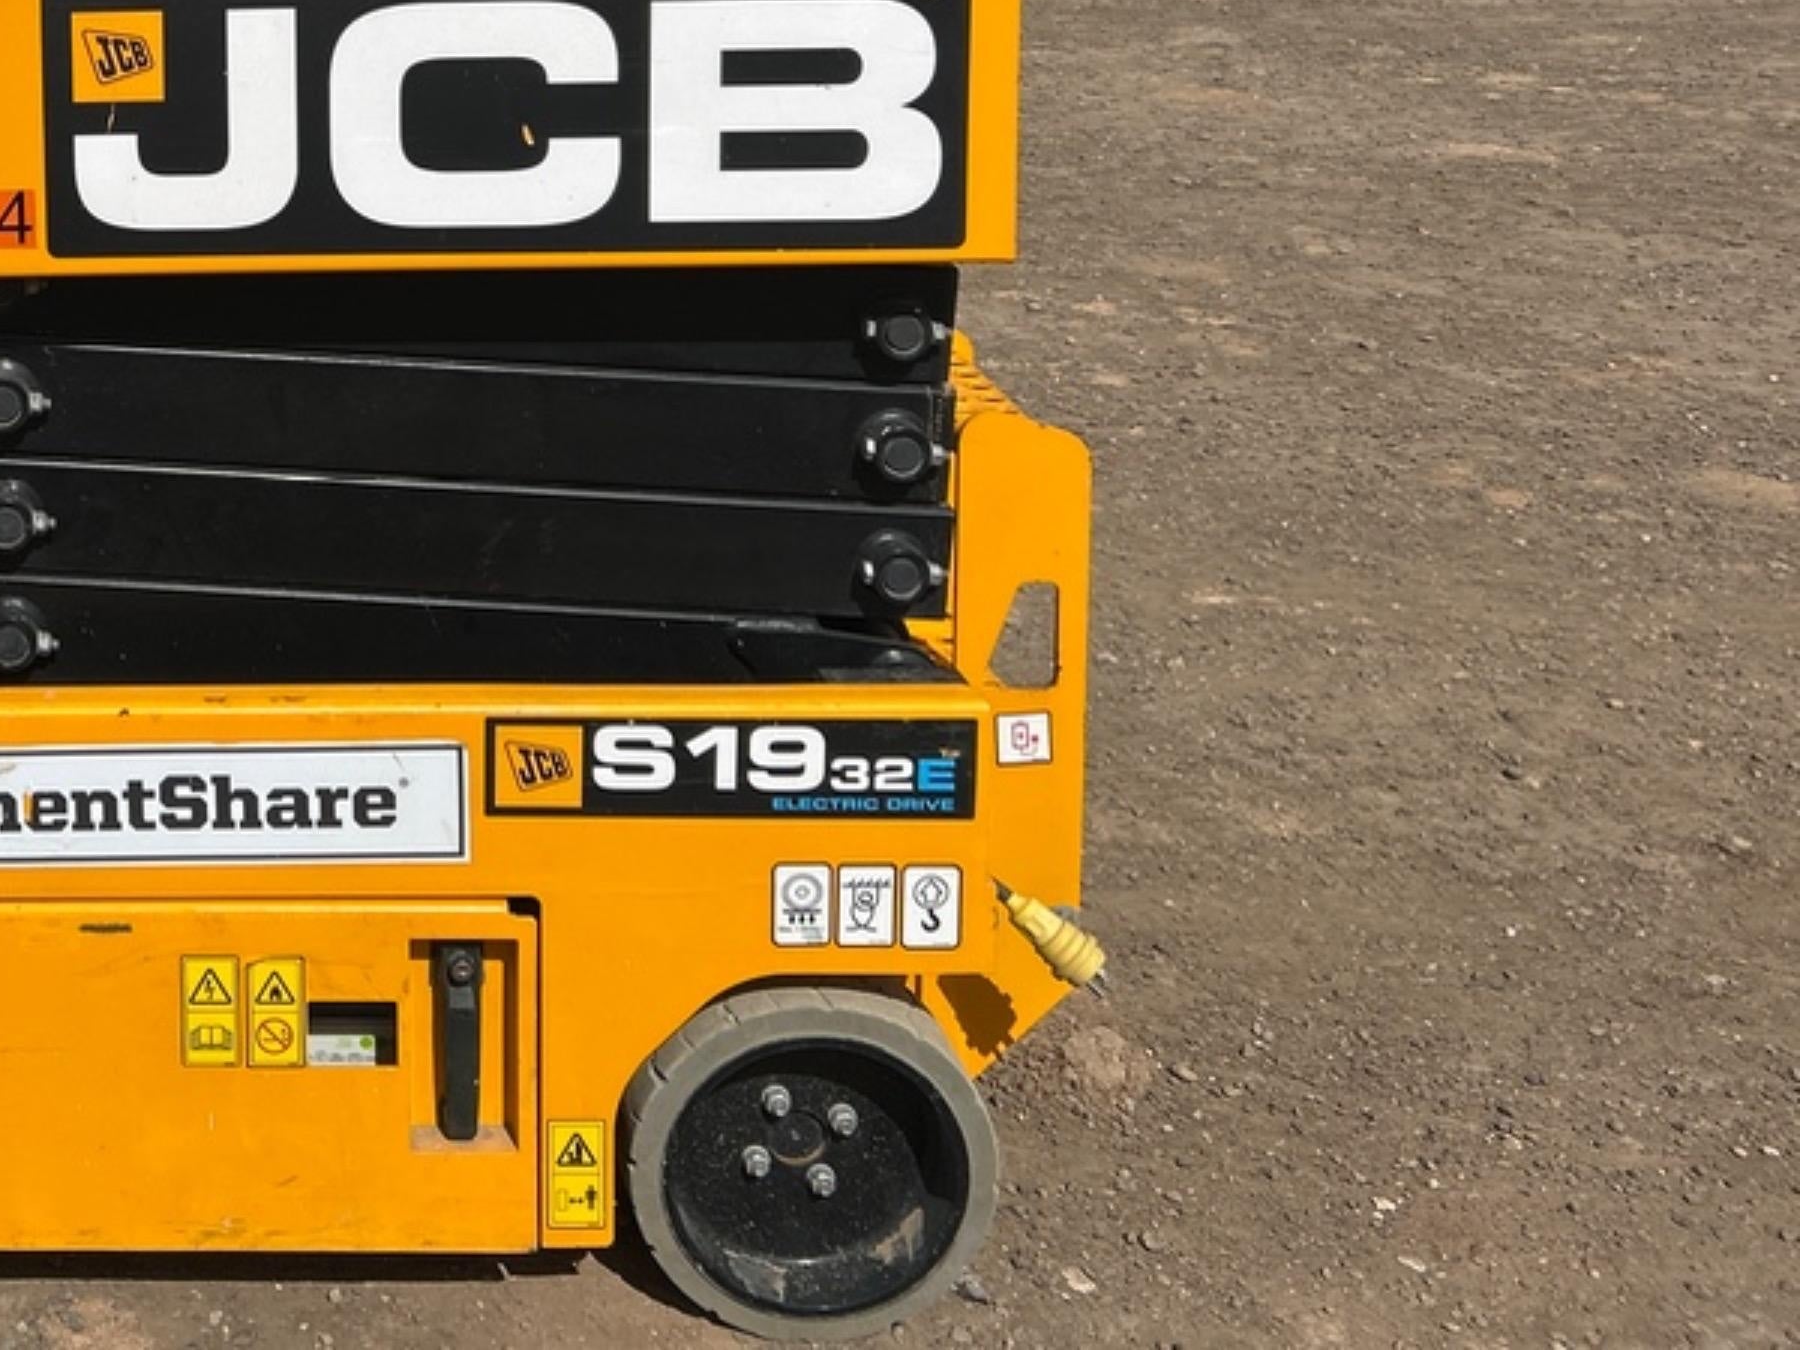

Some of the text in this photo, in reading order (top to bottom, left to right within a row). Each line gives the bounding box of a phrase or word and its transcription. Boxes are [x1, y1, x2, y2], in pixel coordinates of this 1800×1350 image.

[95, 35, 148, 78] JCB
[518, 748, 568, 784] JCB
[771, 796, 956, 812] ELECTRIC DRIVE
